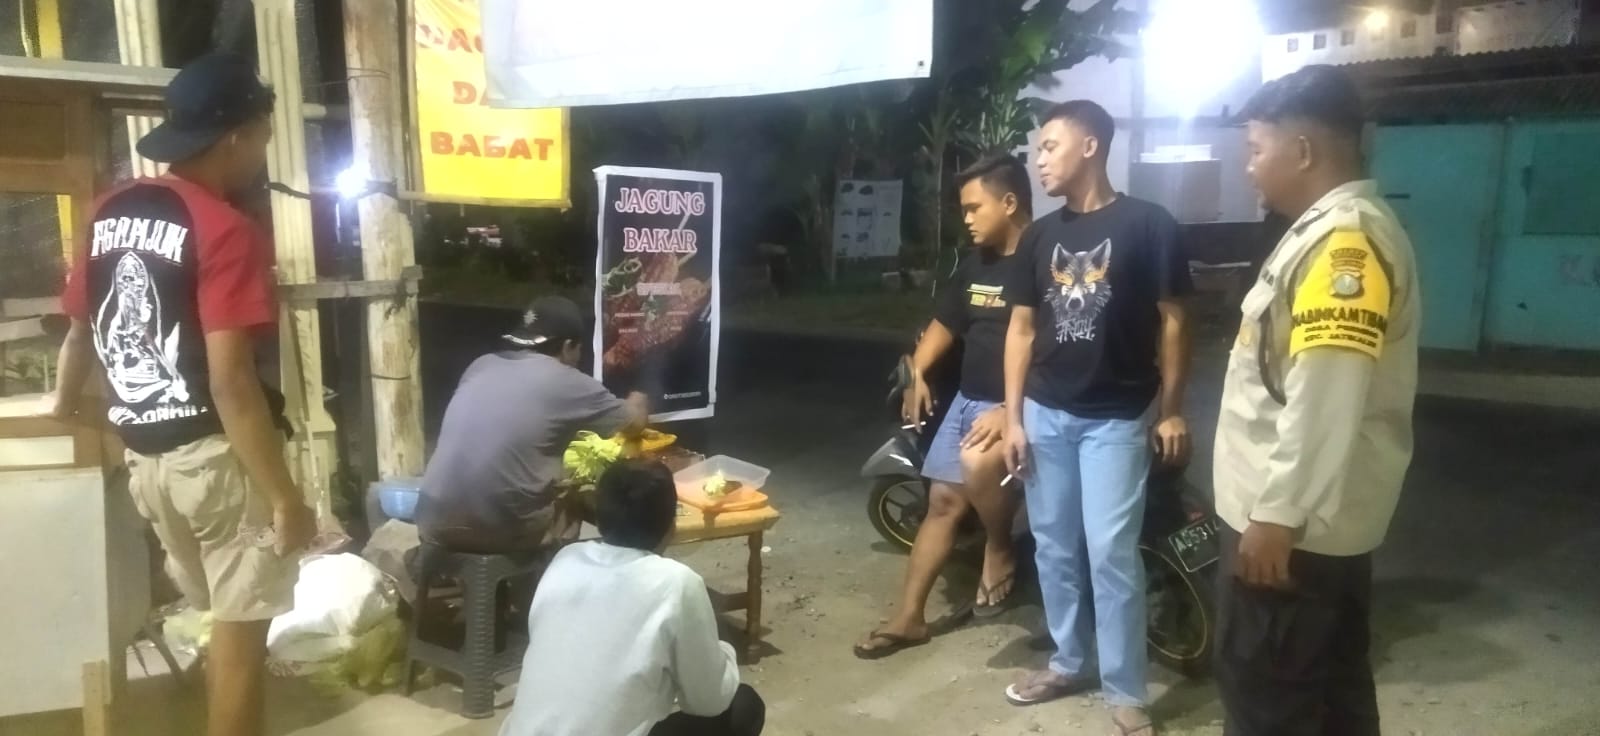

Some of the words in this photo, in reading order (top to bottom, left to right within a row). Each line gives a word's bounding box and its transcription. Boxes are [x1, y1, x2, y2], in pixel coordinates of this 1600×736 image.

[430, 131, 554, 161] BABAT
[615, 187, 706, 215] JAGUNG
[623, 227, 698, 253] BAKAR
